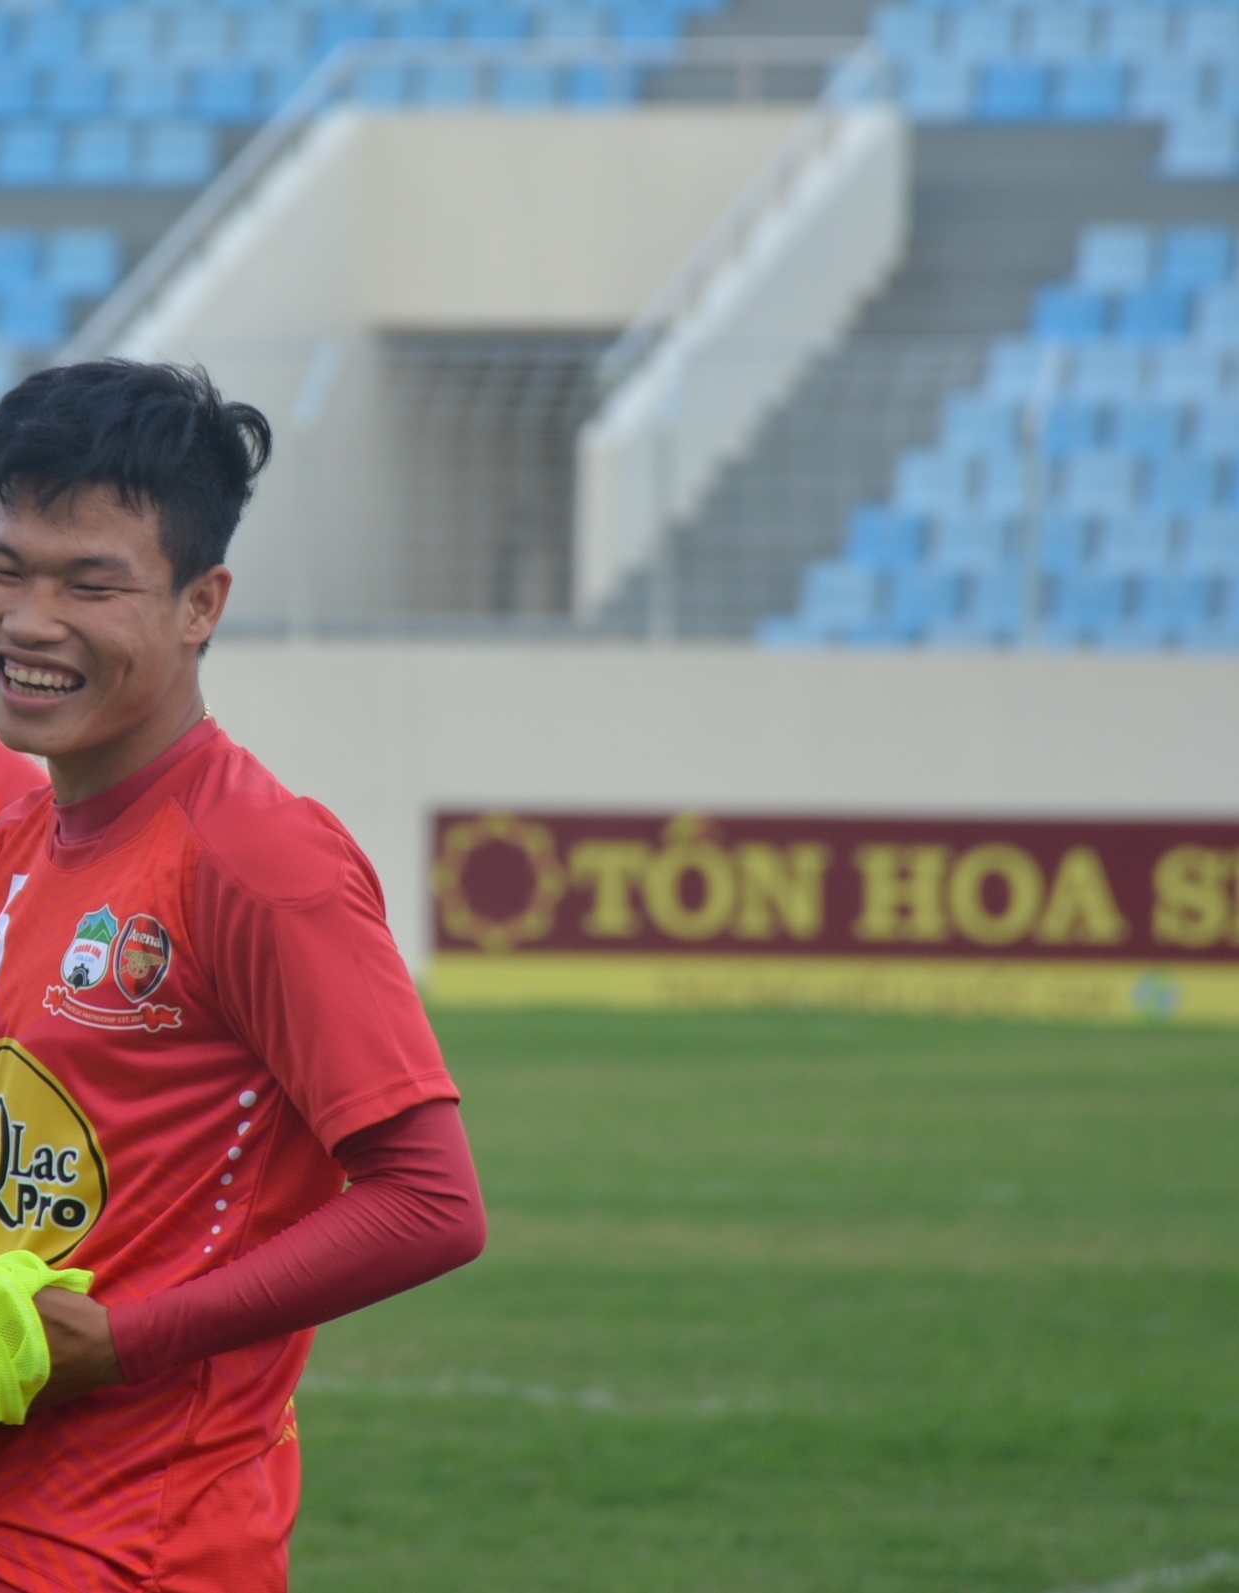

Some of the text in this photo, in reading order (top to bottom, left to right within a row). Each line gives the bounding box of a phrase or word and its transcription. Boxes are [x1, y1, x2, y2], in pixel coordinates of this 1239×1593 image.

[567, 812, 833, 940] TÔN
[853, 842, 1130, 945] HOA
[9, 1122, 78, 1184] Lac
[16, 1181, 87, 1228] Pro
